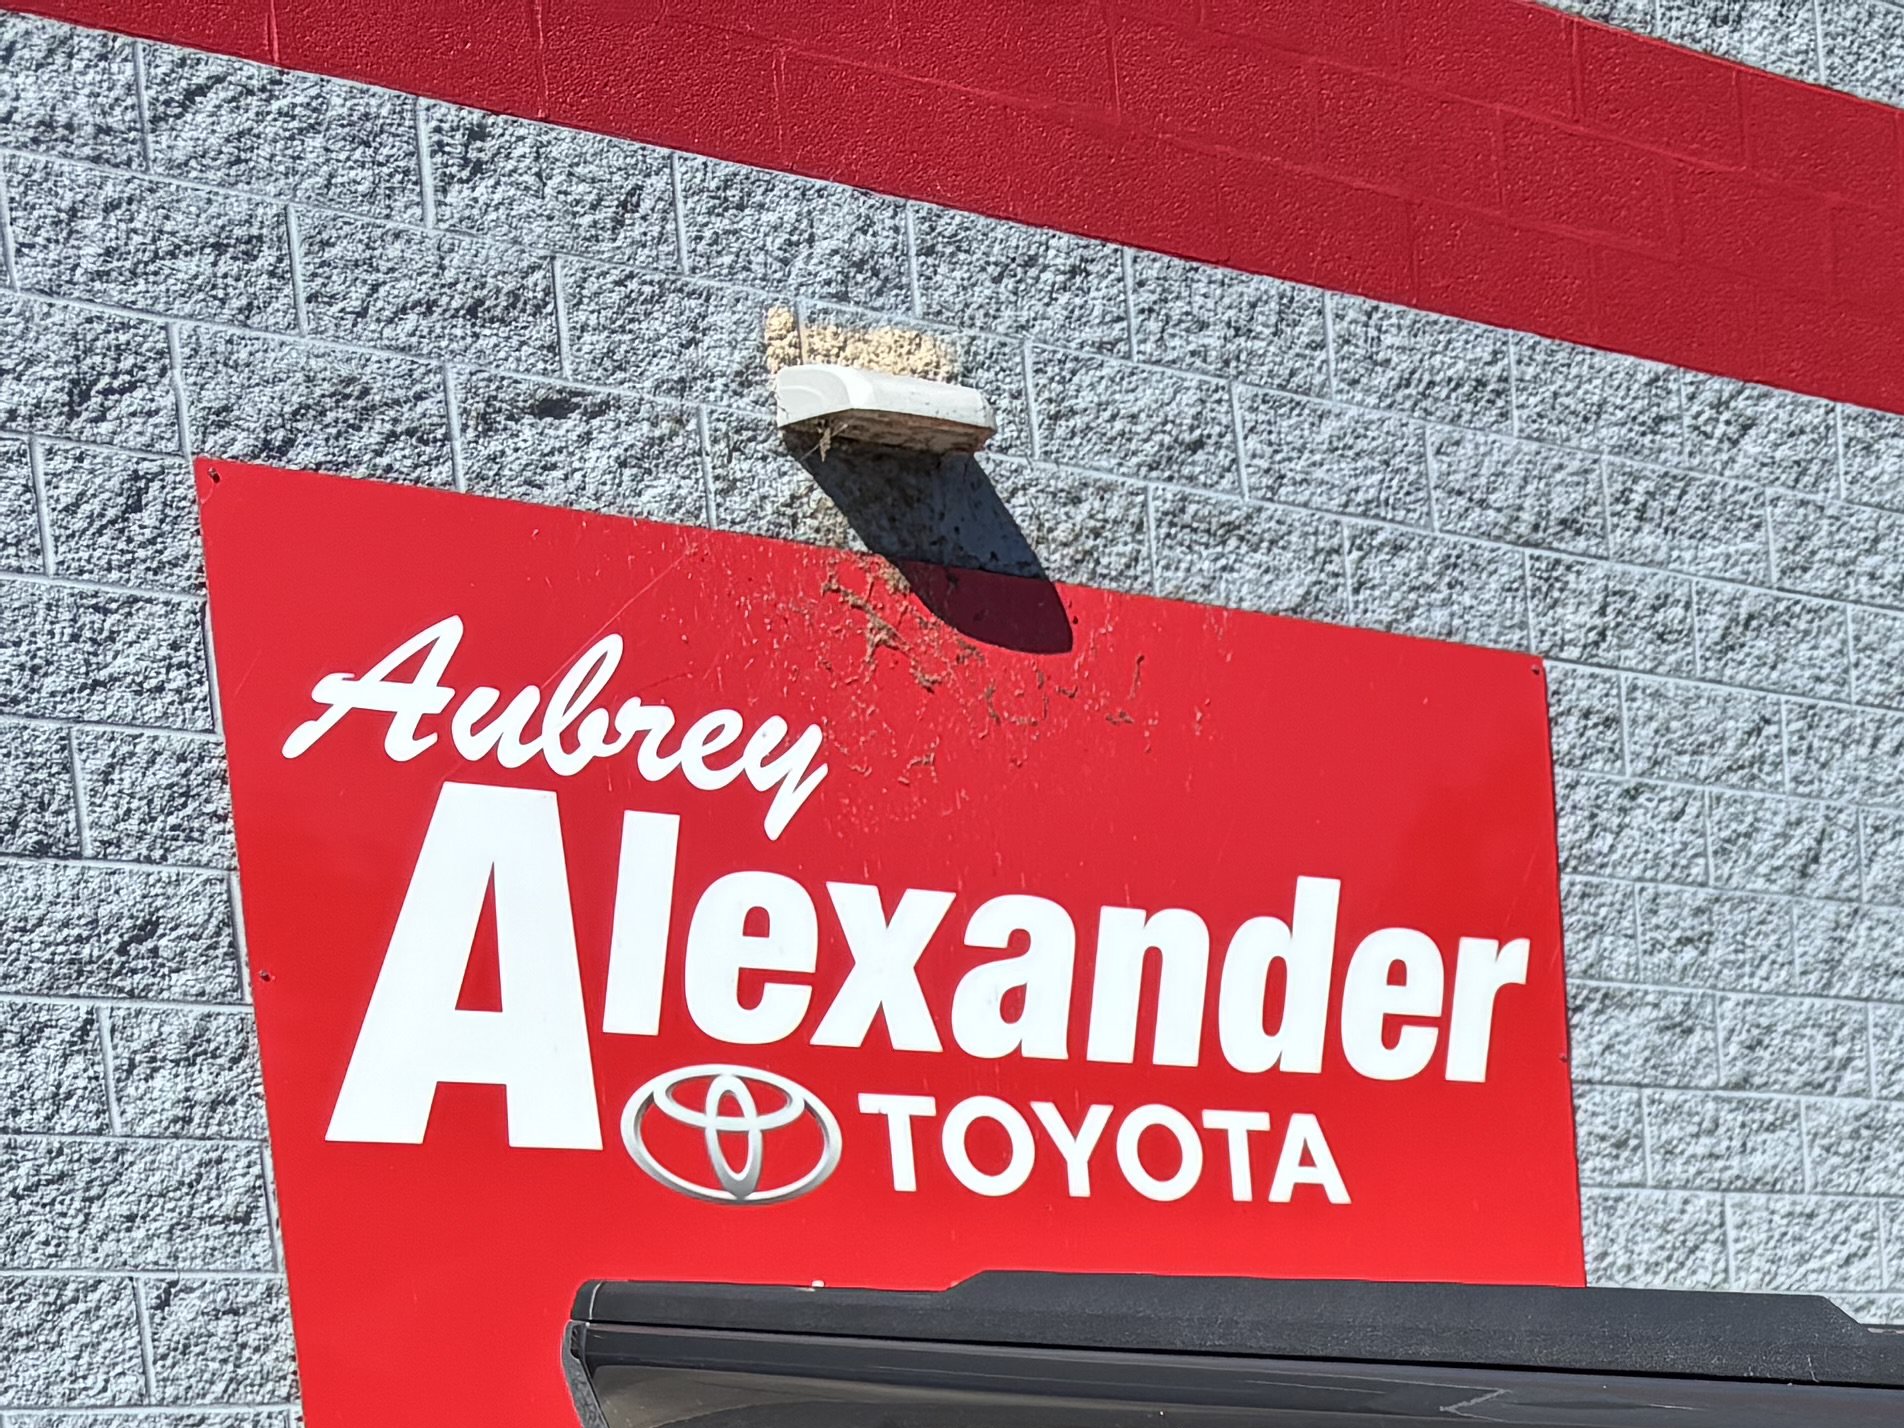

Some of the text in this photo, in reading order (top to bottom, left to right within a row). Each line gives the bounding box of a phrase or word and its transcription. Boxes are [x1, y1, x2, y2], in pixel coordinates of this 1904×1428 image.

[281, 614, 828, 840] Aubrey
[325, 781, 1530, 1150] Alexander
[857, 1092, 1352, 1206] TOYOTA
